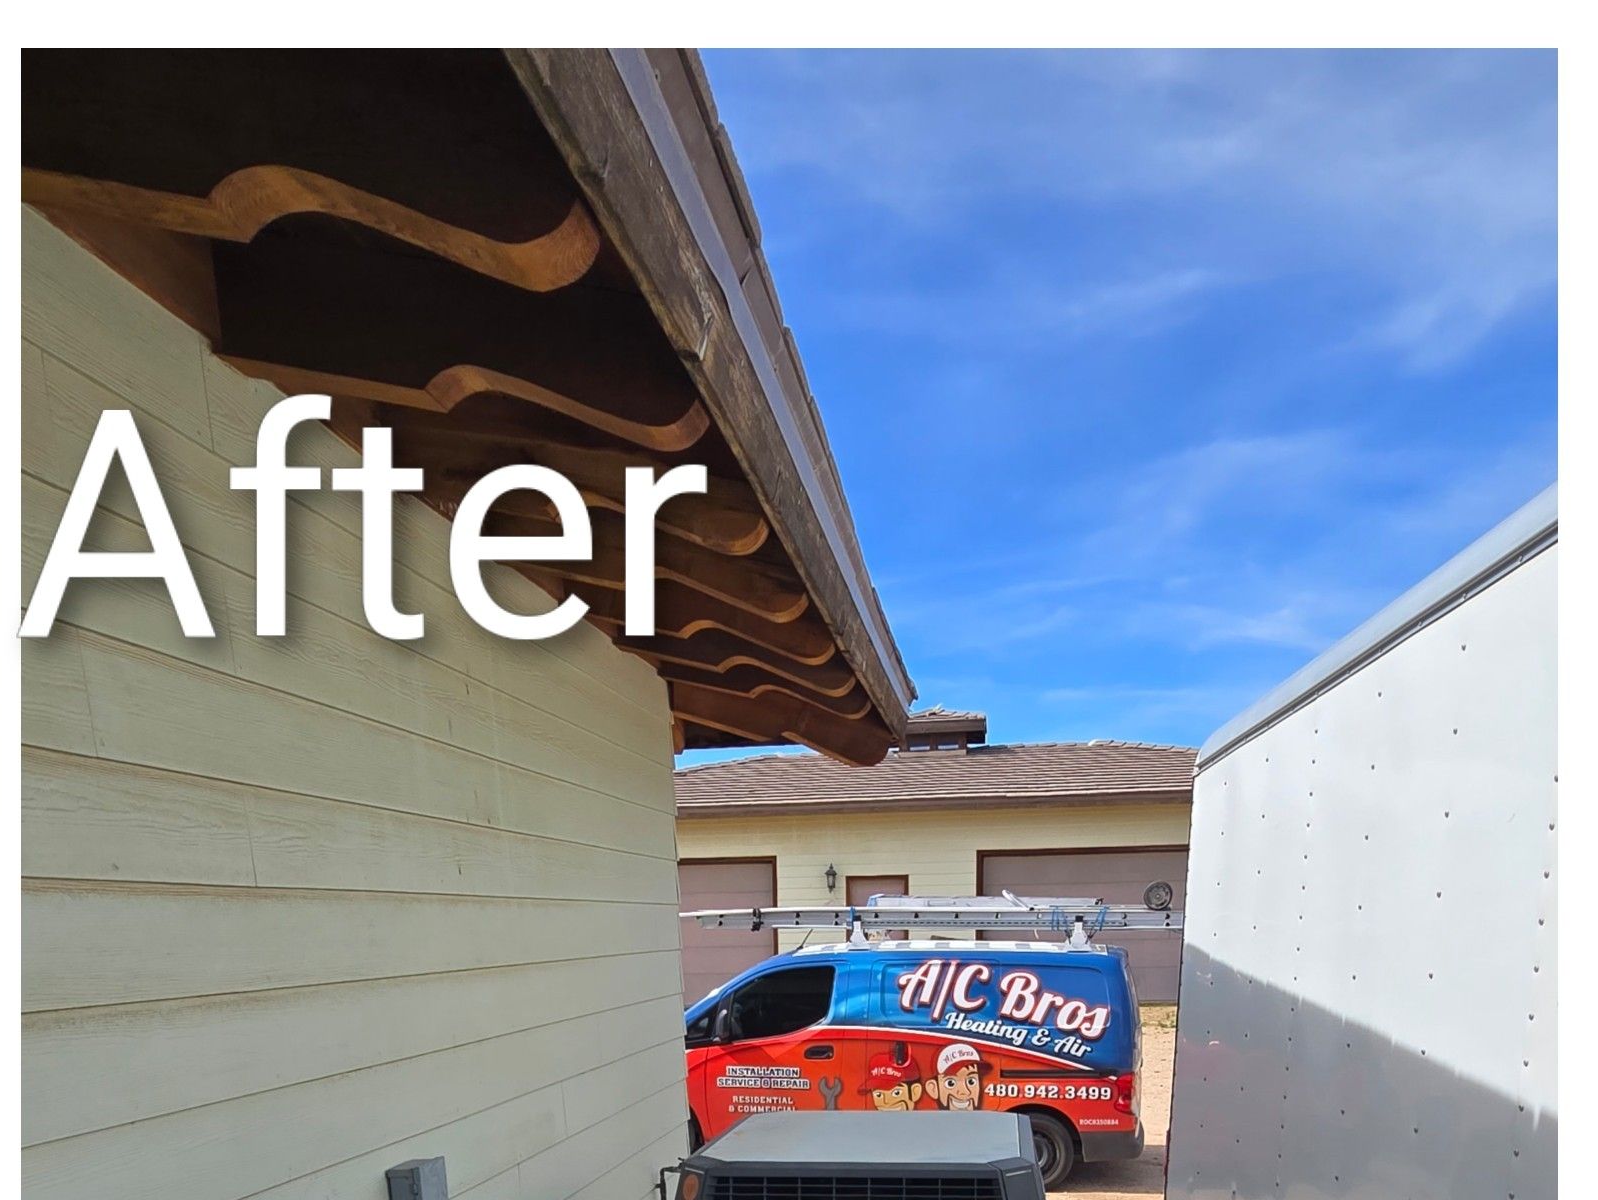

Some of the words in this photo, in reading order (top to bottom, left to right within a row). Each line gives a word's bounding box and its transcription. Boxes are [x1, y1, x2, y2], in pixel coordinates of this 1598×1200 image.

[1000, 971, 1110, 1039] Bros
[945, 1012, 1029, 1045] Heating
[1031, 1029, 1052, 1046] &
[1054, 1036, 1092, 1058] Air
[958, 1049, 974, 1058] Bros
[726, 1066, 800, 1077] INSTALLATION
[887, 1067, 902, 1078] Bros
[717, 1077, 760, 1088] SERVICE
[771, 1079, 810, 1089] REPAIR
[984, 1084, 1111, 1100] 480.942.3499
[732, 1095, 793, 1105] RESIDENTIAL
